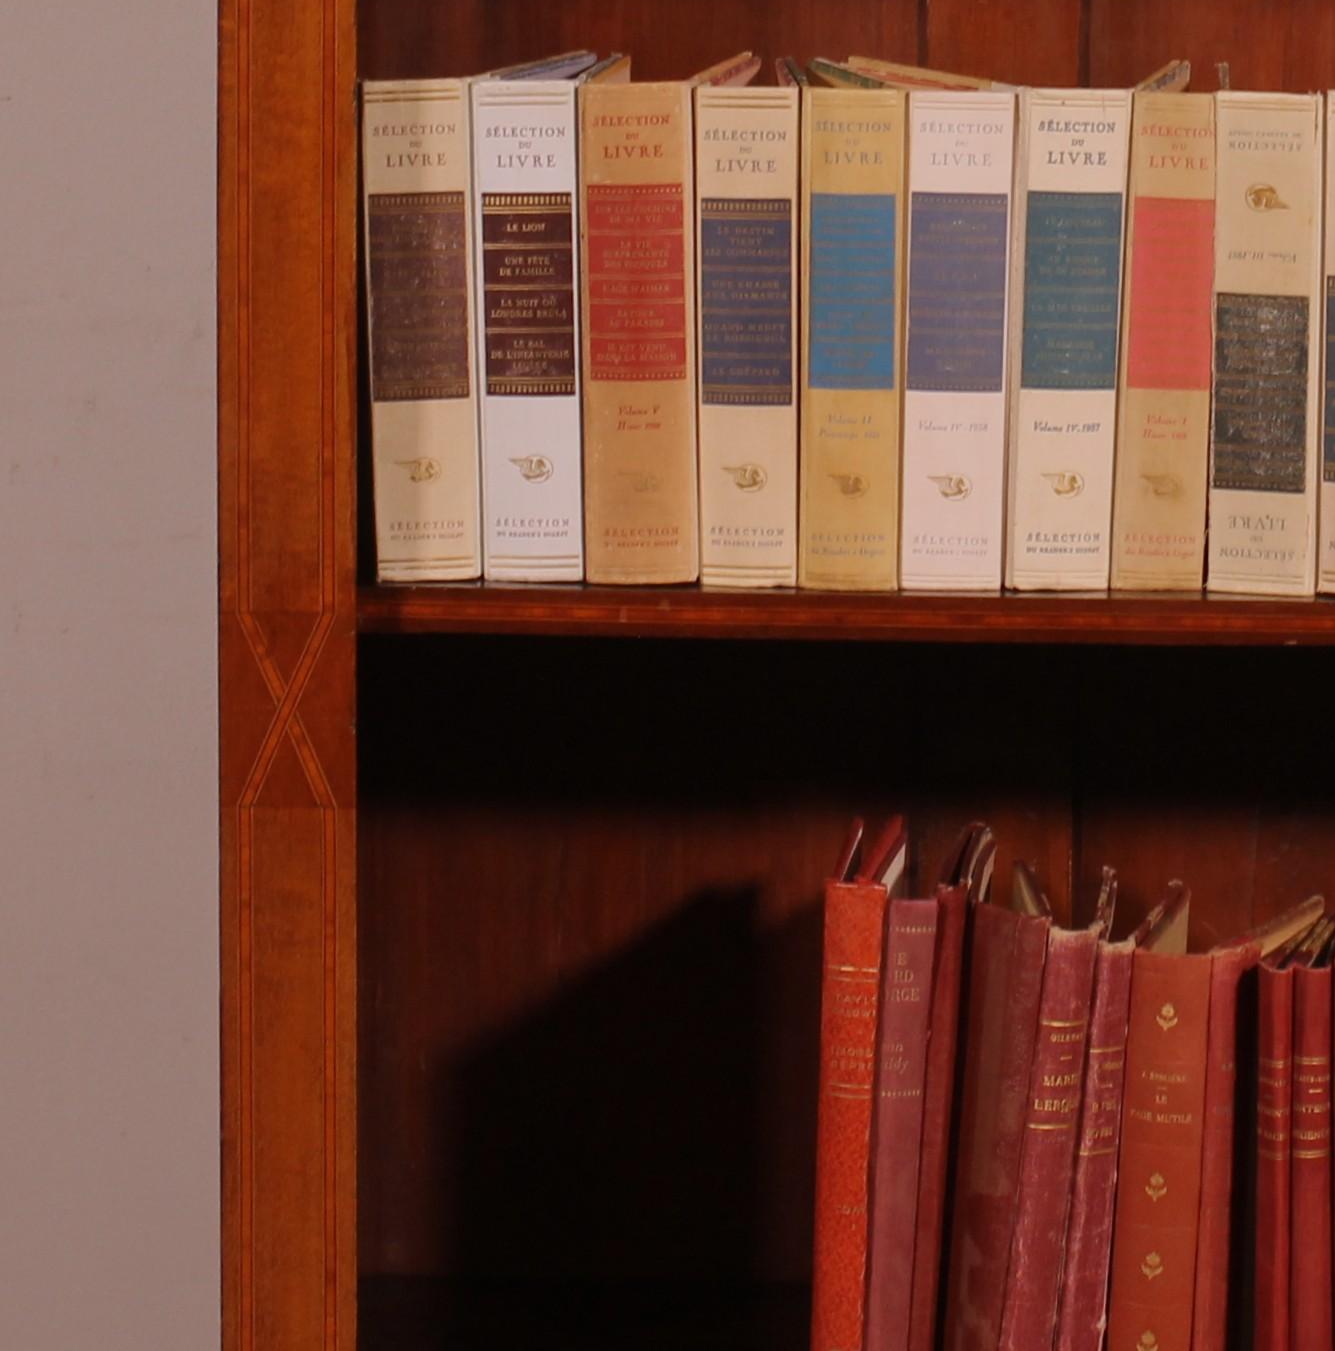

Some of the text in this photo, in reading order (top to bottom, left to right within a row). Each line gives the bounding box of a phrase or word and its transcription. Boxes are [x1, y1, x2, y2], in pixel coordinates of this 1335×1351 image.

[592, 114, 671, 127] SÉLECTION
[816, 120, 892, 133] SÉLECTION
[920, 121, 1005, 134] SÉLECTION
[1038, 119, 1116, 133] SÉLECTION
[372, 123, 456, 137] SÉLECTION
[485, 126, 566, 139] SÉLECTION
[704, 128, 787, 141] SÉLECTION
[518, 141, 532, 150] DU
[603, 144, 664, 159] LIVRE
[385, 154, 447, 168] LIVRE
[496, 154, 557, 169] LIVRE
[824, 151, 883, 165] LIVRE
[930, 152, 992, 167] LIVRE
[1047, 151, 1107, 166] LIVRE
[1149, 155, 1208, 170] LIVRE
[715, 159, 777, 173] LIVRE
[521, 224, 546, 232] LION
[1228, 515, 1286, 532] LIVRE
[1219, 547, 1296, 562] SÉLECTION
